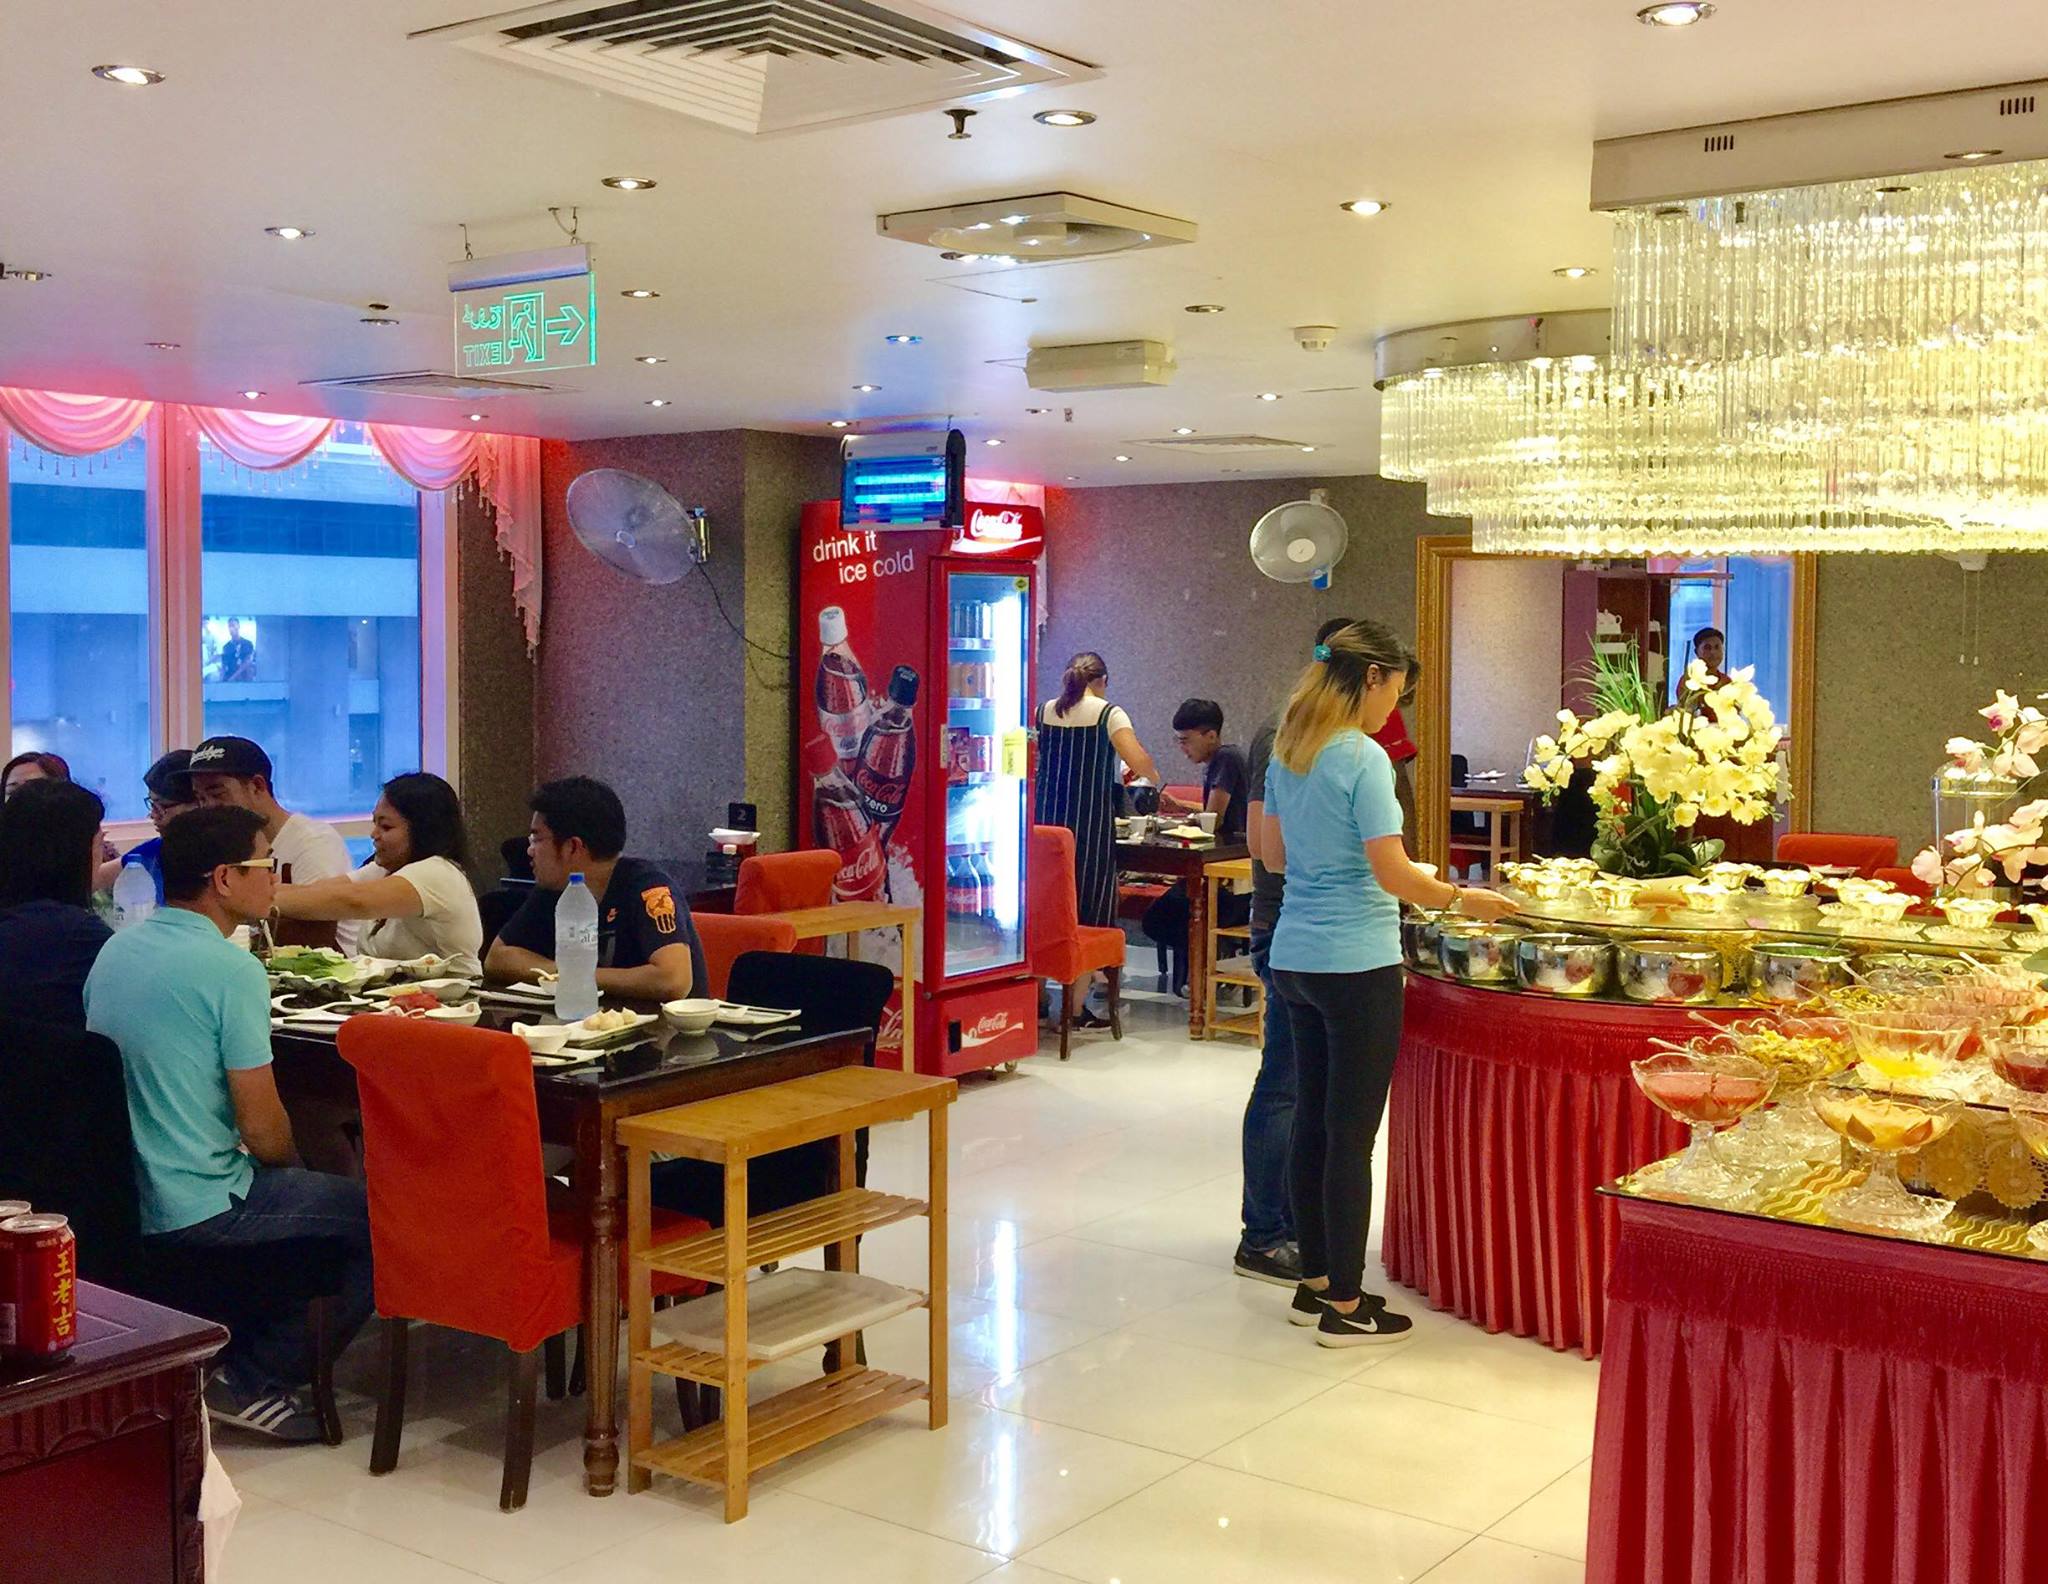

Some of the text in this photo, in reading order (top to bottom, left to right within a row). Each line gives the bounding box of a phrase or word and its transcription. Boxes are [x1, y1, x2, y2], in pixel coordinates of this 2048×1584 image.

[812, 530, 877, 563] drink it
[838, 549, 915, 585] ice cold
[52, 1250, 73, 1336] 王老吉
